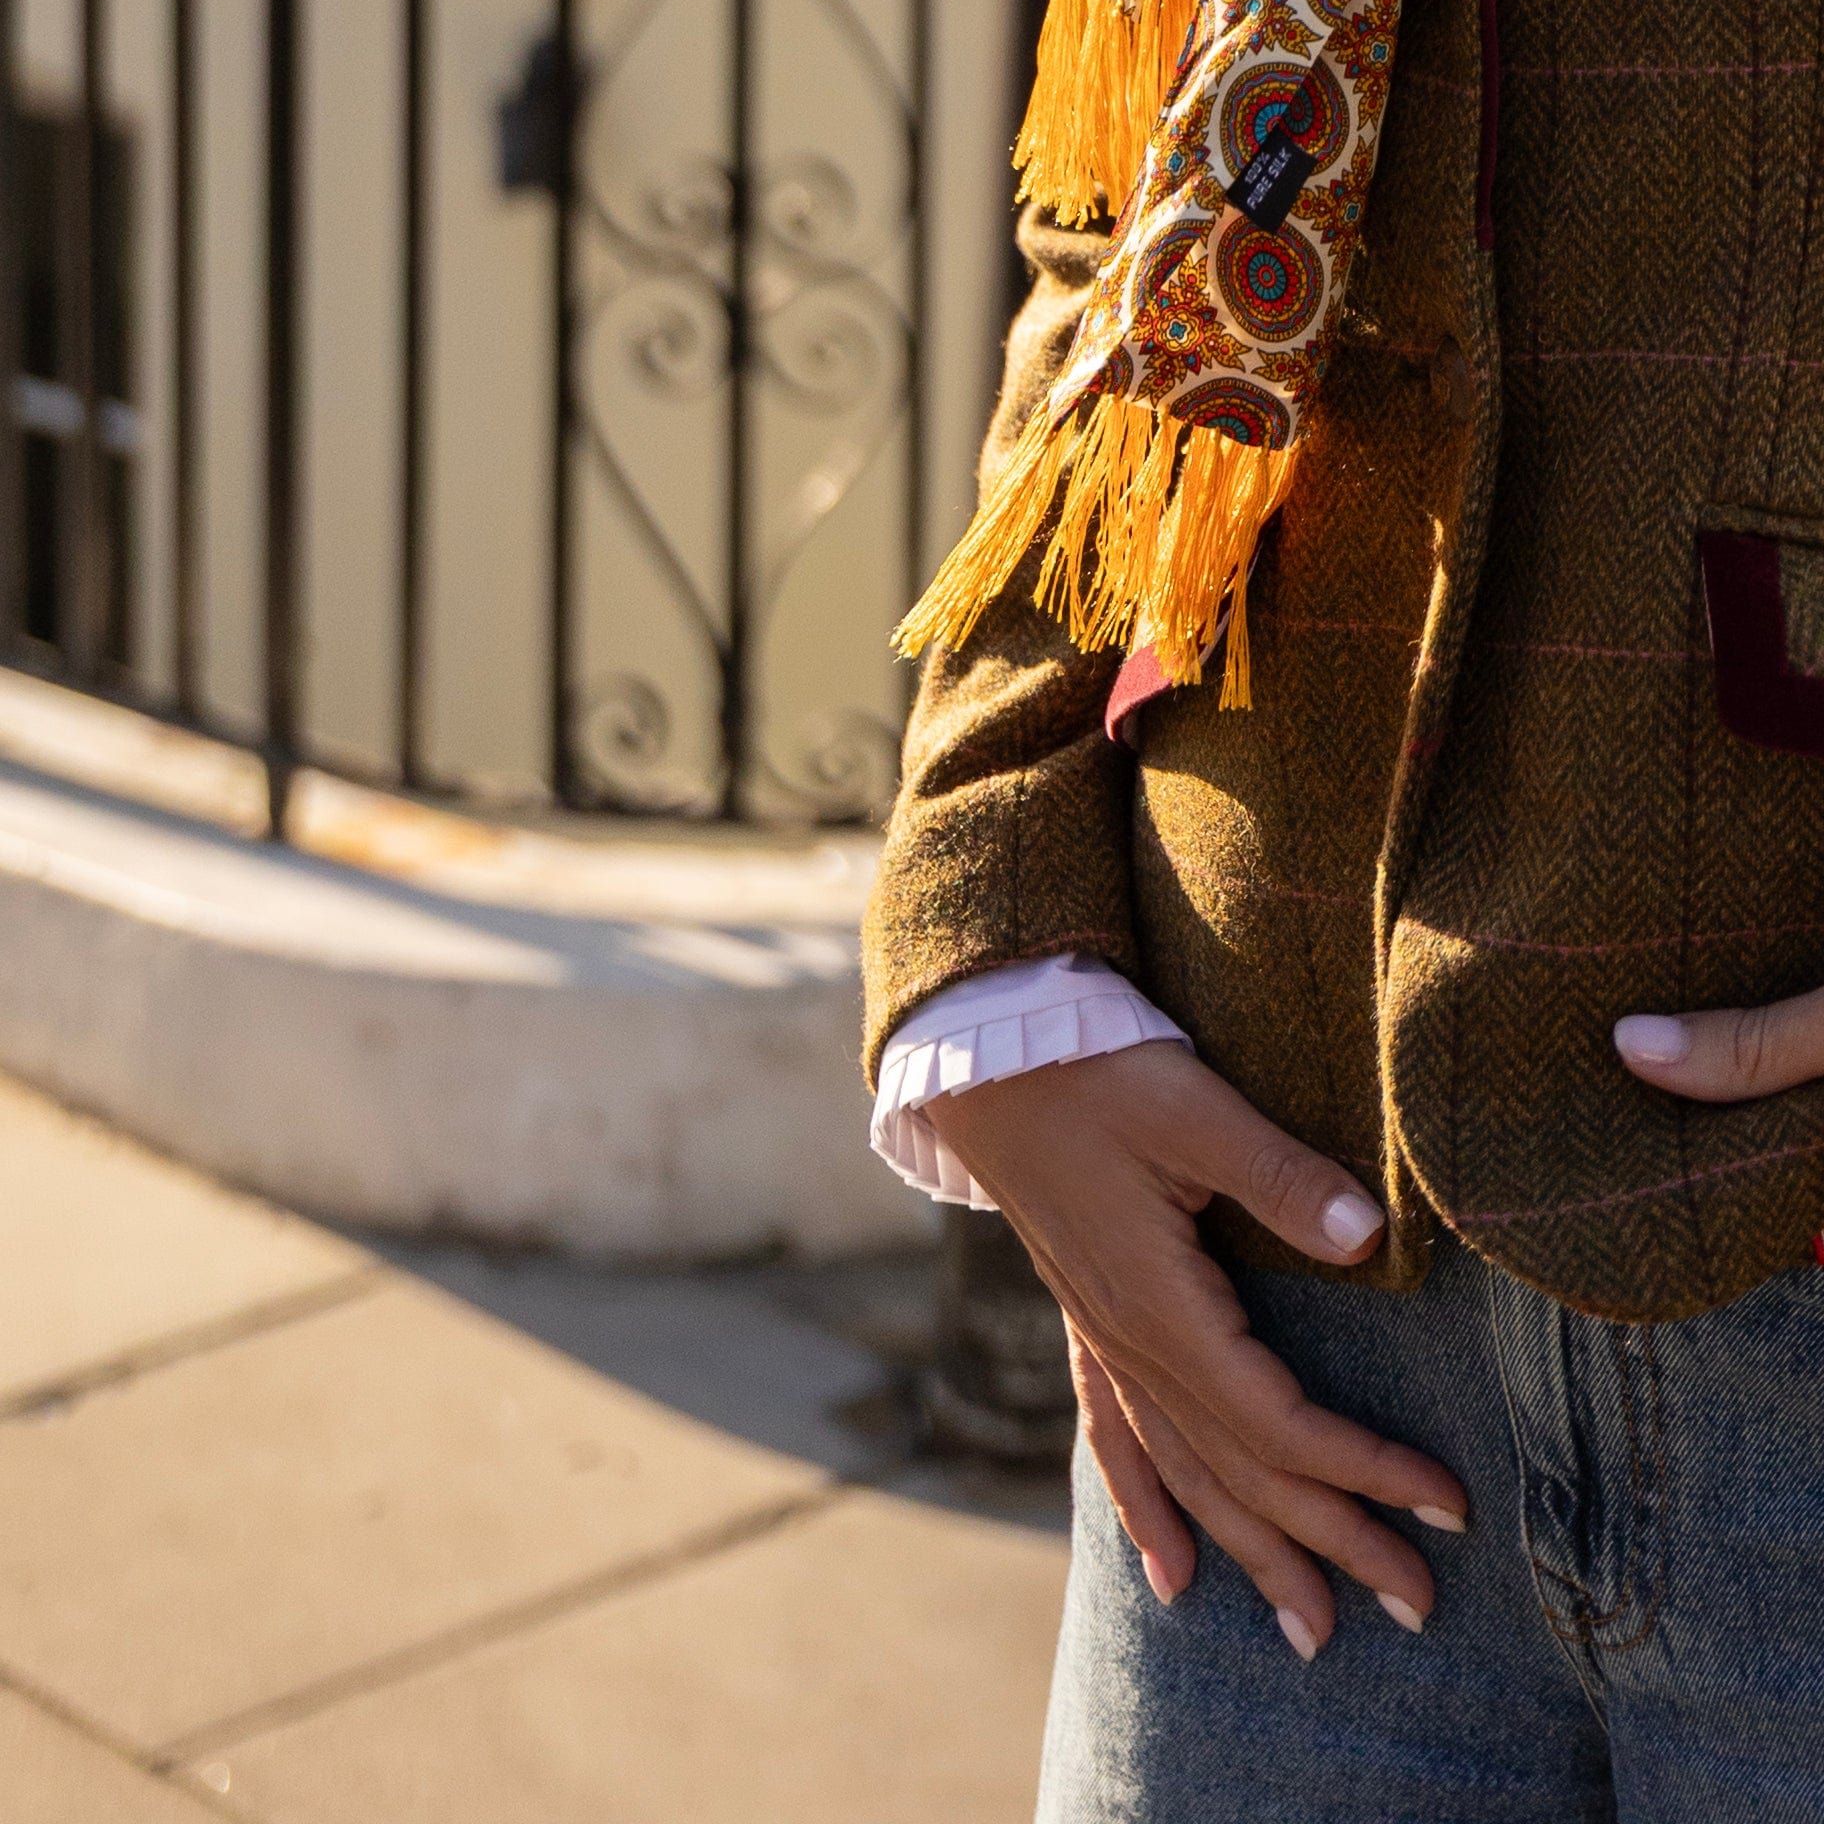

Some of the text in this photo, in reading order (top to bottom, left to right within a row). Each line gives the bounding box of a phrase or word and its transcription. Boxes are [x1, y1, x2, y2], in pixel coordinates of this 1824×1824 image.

[1245, 152, 1270, 183] 100%
[1246, 147, 1292, 210] PURE SILK
